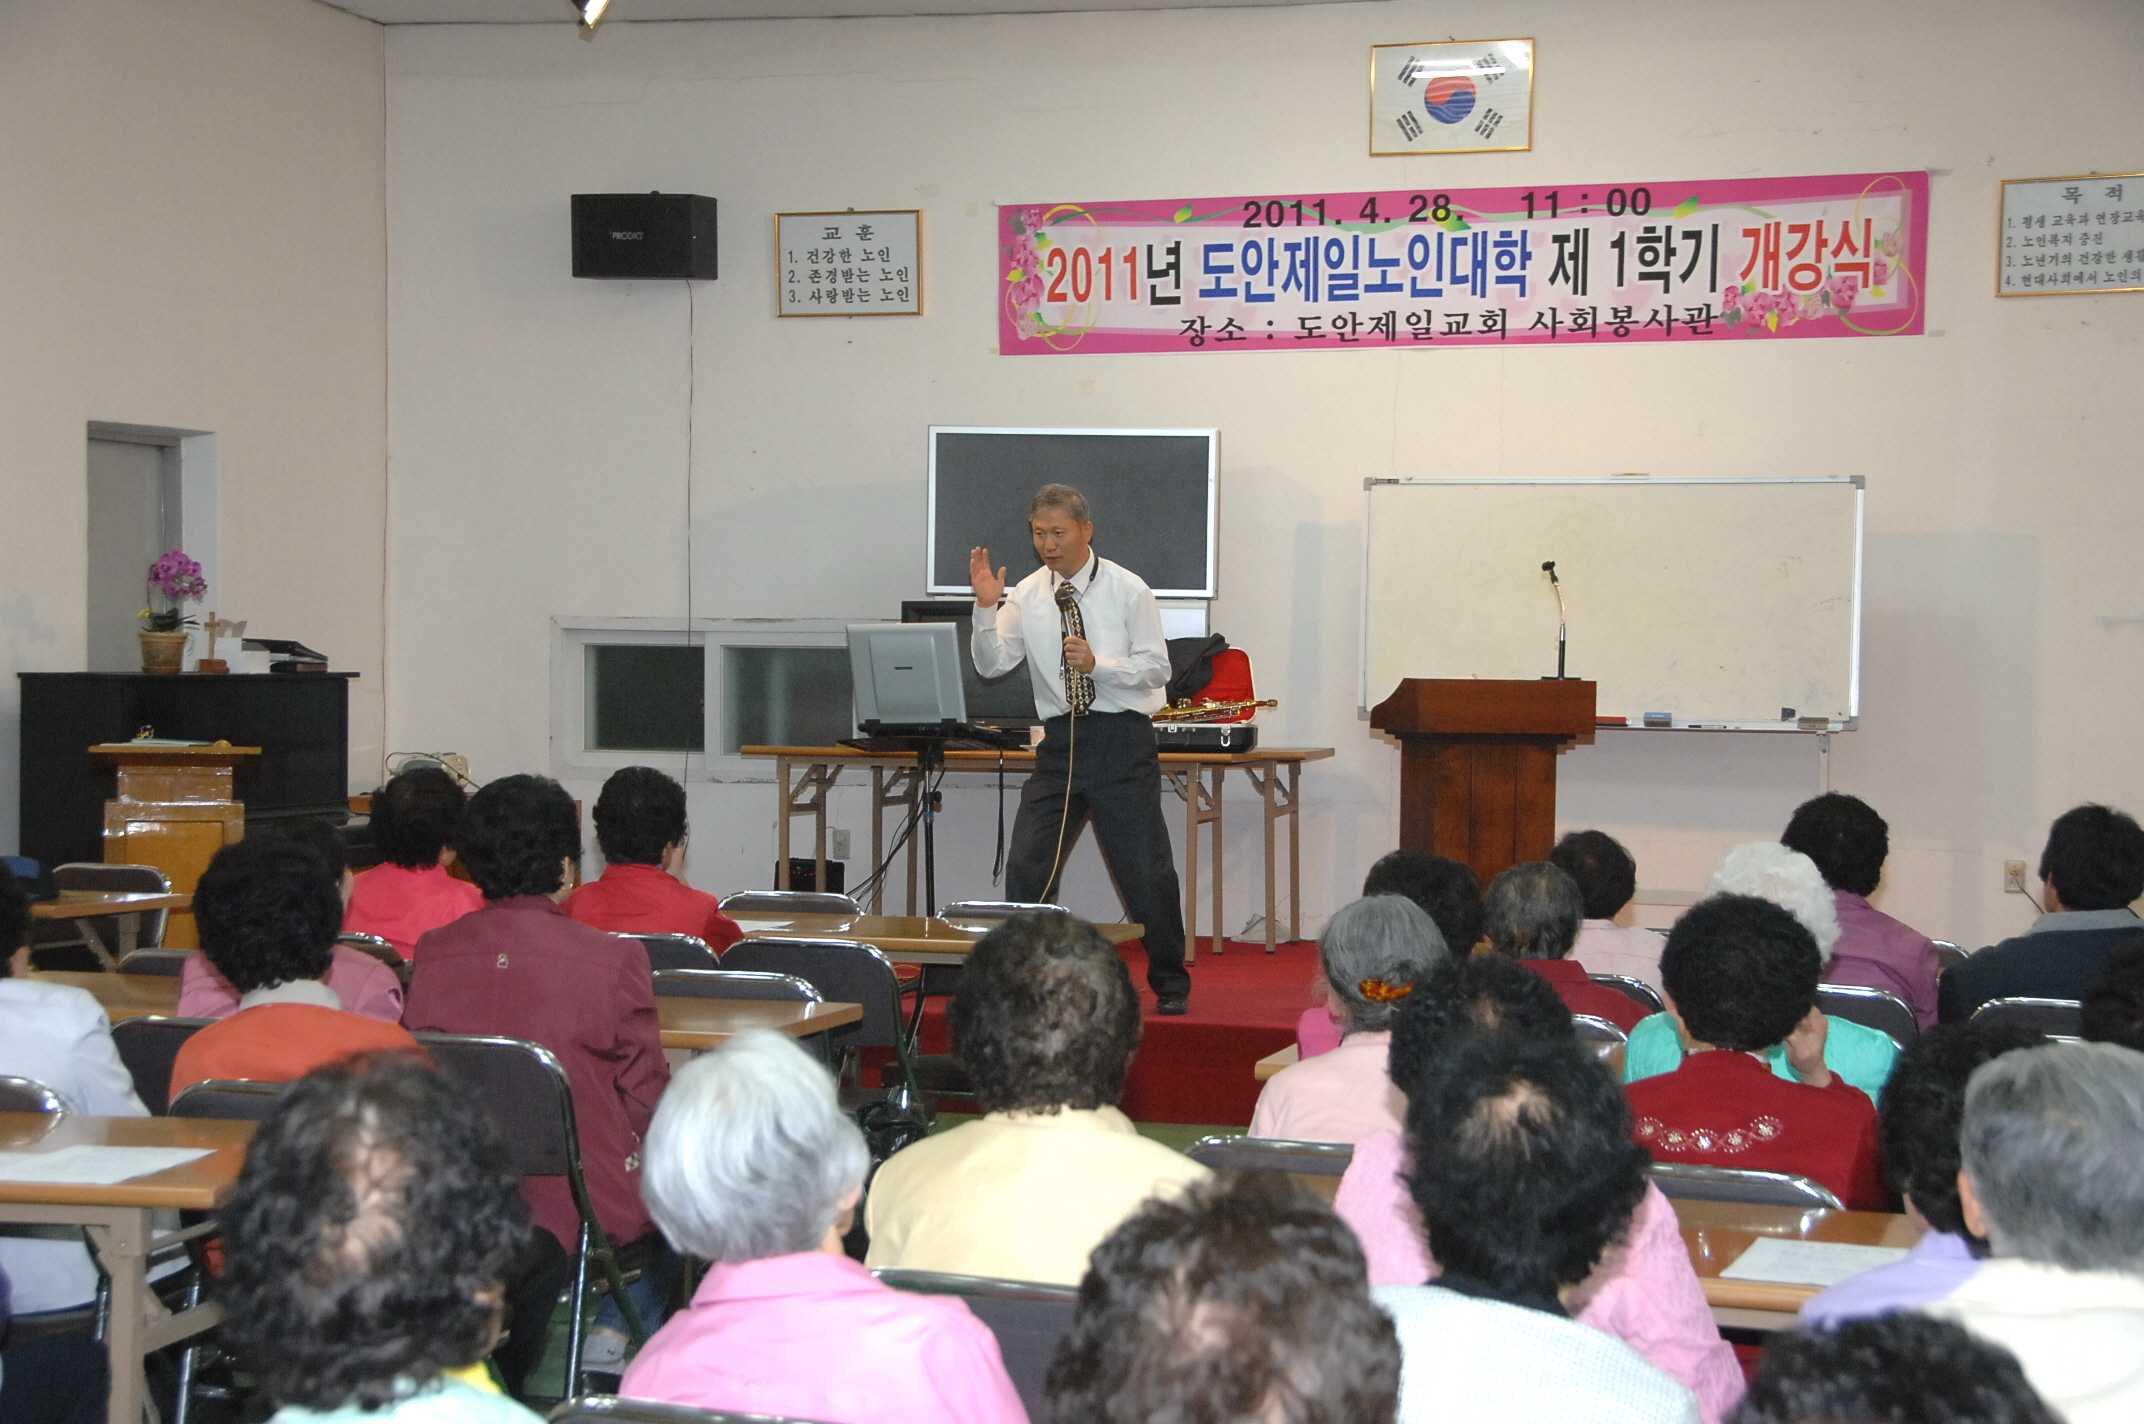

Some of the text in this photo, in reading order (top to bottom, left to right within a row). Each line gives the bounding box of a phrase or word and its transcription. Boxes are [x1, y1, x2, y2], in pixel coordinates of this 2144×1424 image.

[1243, 198, 1342, 228] 2011.
[1360, 197, 1391, 224] 4.
[1408, 194, 1464, 223] 28.
[2022, 233, 2072, 248] 노인복지
[788, 246, 891, 264] 1. 건강한 노인
[1046, 240, 1182, 306] 2011년
[1198, 229, 1532, 303] 도안제일노인대학
[1740, 217, 1873, 292] 개강식
[2021, 253, 2072, 267] 노년기의
[2079, 250, 2116, 265] 건강한
[788, 266, 909, 284] 2. 존경받는 노인
[2103, 268, 2141, 283] 노인의
[788, 286, 909, 304] 3. 사랑받는 노인
[1294, 306, 1508, 344] 도안제일교회
[1528, 303, 1719, 340] 사회봉사관
